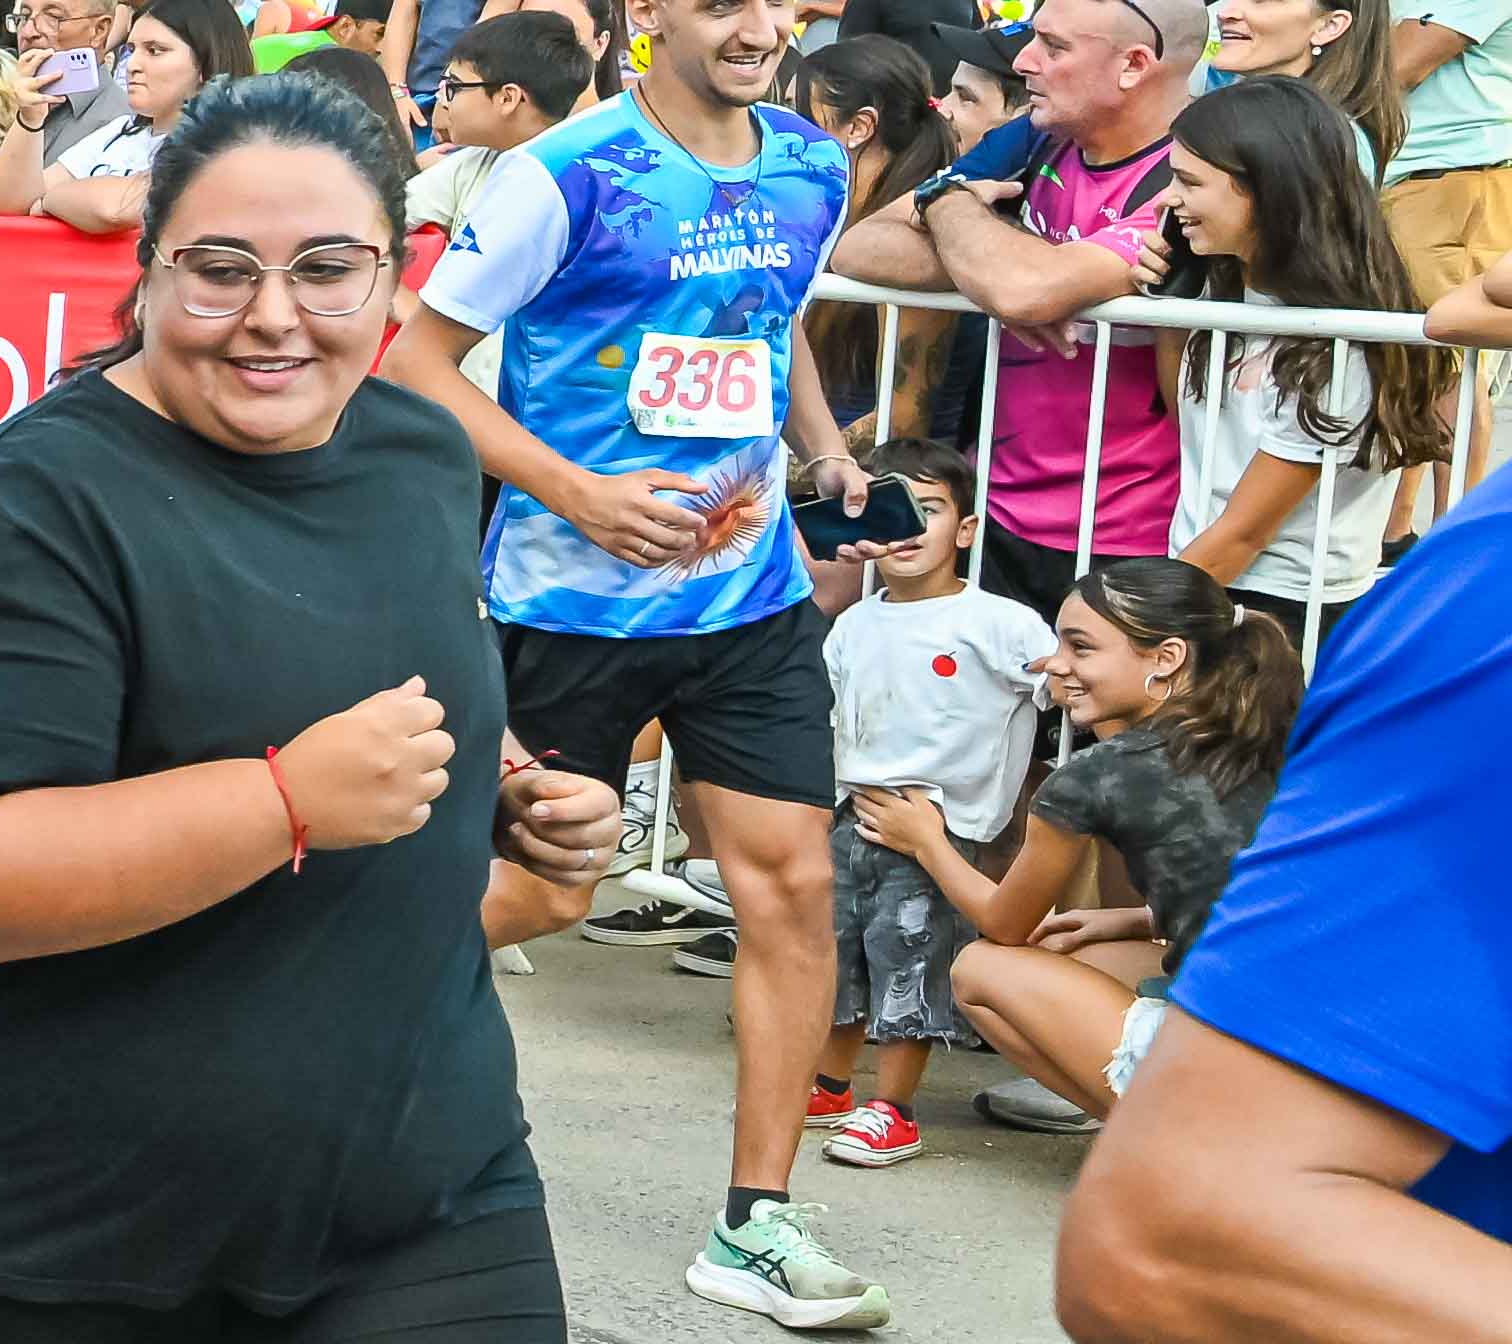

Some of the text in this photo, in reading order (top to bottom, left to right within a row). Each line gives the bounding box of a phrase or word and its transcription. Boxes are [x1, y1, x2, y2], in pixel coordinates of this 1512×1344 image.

[755, 226, 776, 239] DE
[670, 242, 792, 281] MALVINAS
[638, 346, 757, 413] 336
